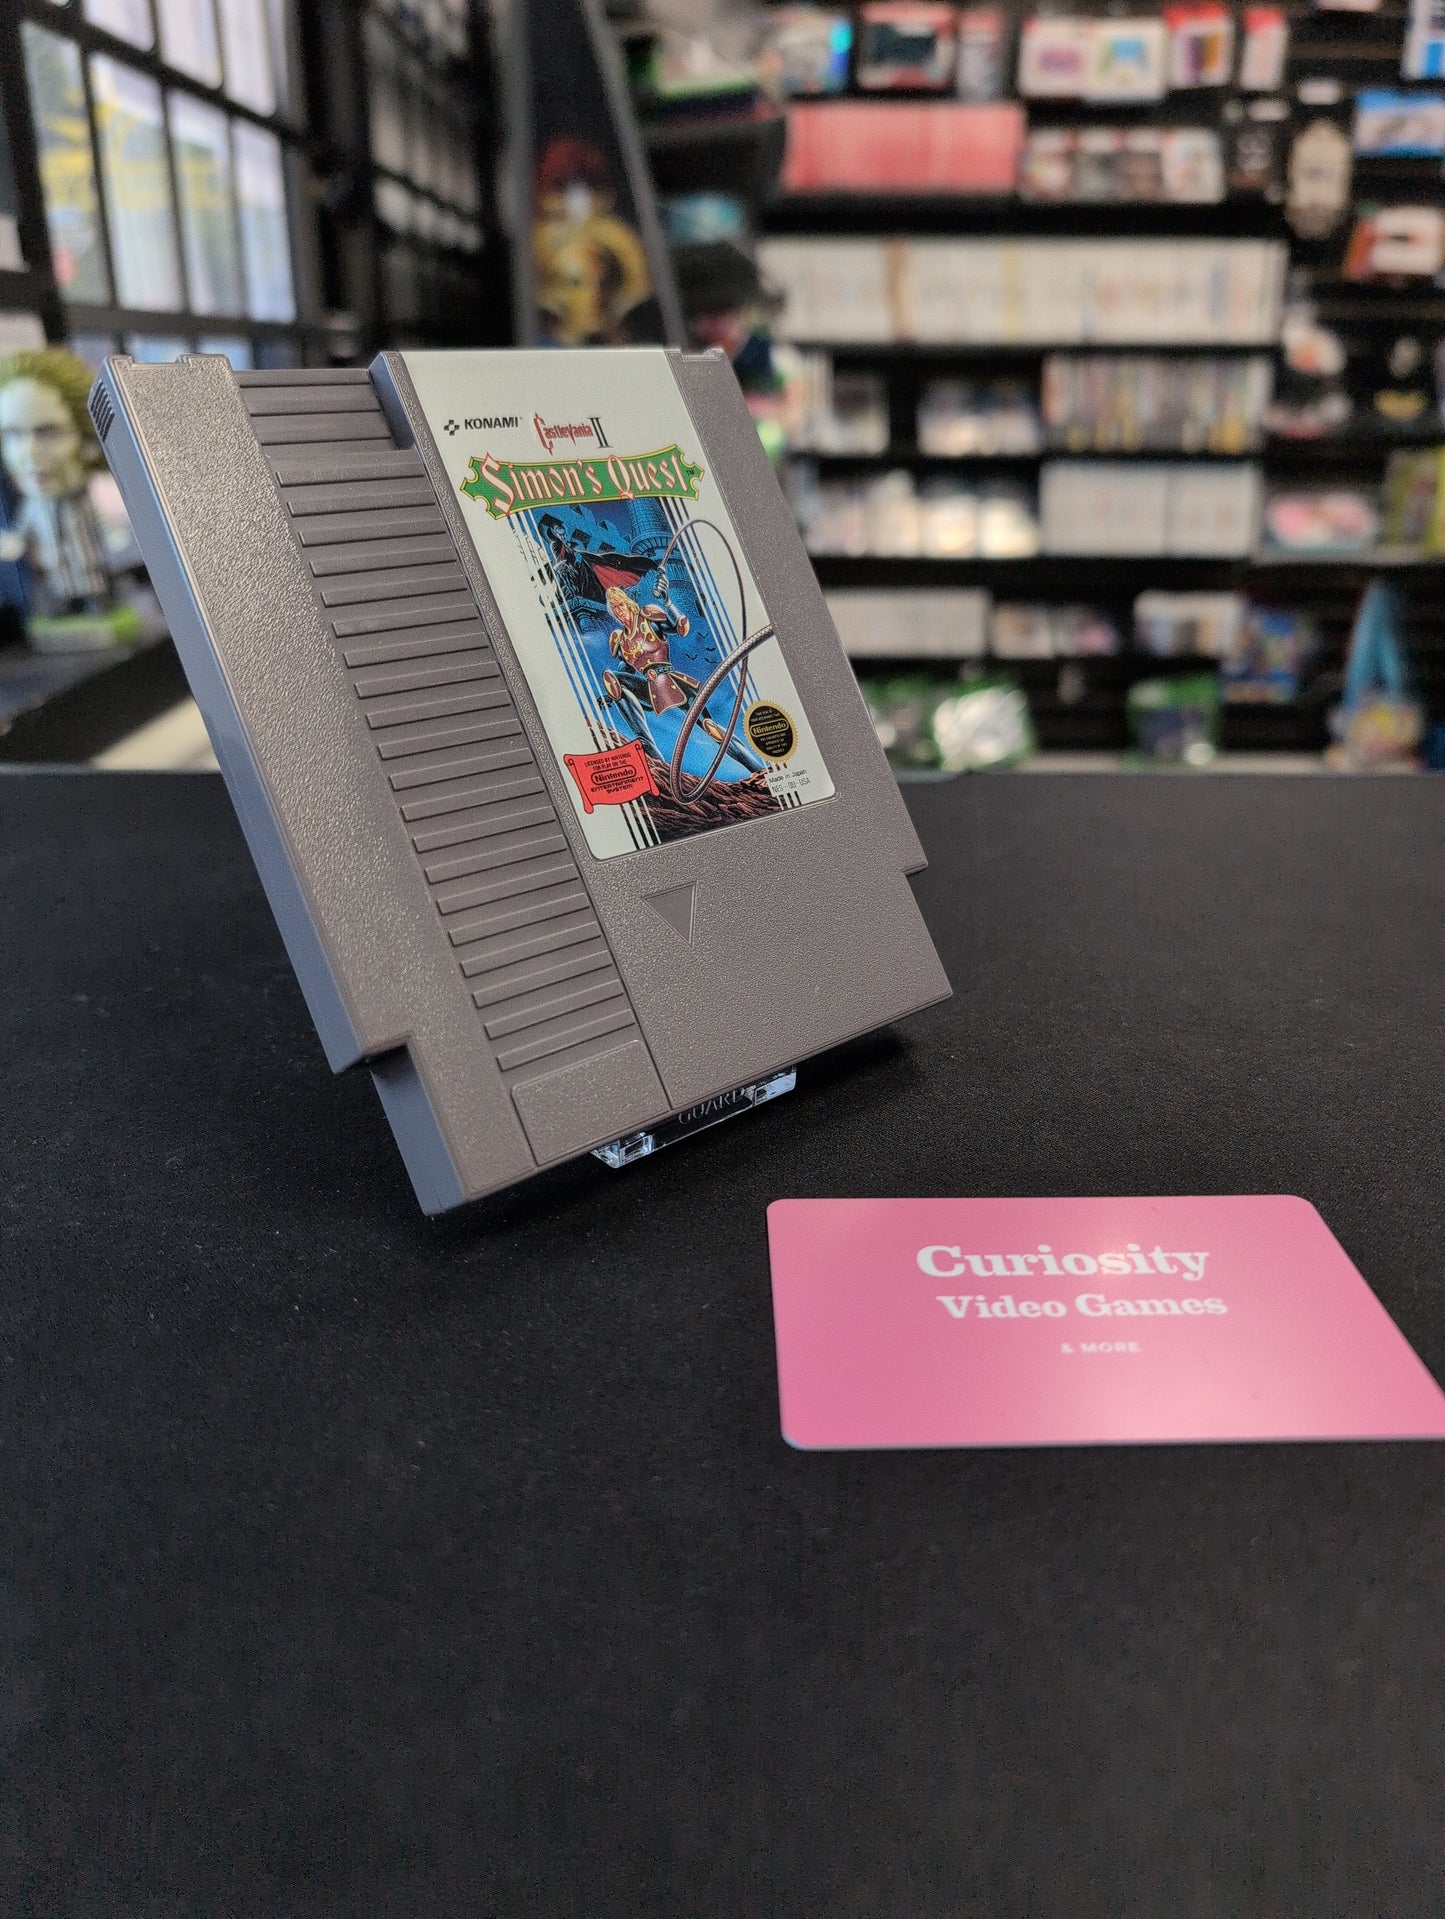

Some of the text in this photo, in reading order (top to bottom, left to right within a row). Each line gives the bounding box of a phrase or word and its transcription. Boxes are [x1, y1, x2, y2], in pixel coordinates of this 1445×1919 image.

[464, 416, 519, 430] KONAMI
[587, 416, 614, 450] II
[479, 451, 604, 517] Simon's
[606, 453, 690, 501] Quest
[752, 721, 787, 735] Nintendo
[584, 758, 605, 768] LICENSED
[610, 752, 631, 761] NINTENDO
[594, 768, 634, 783] Nintendo
[769, 775, 785, 783] Made
[791, 769, 808, 777] Japan
[916, 1243, 1210, 1281] Curiosity
[936, 1293, 1228, 1319] Video Games
[1060, 1341, 1141, 1354] & MORE
